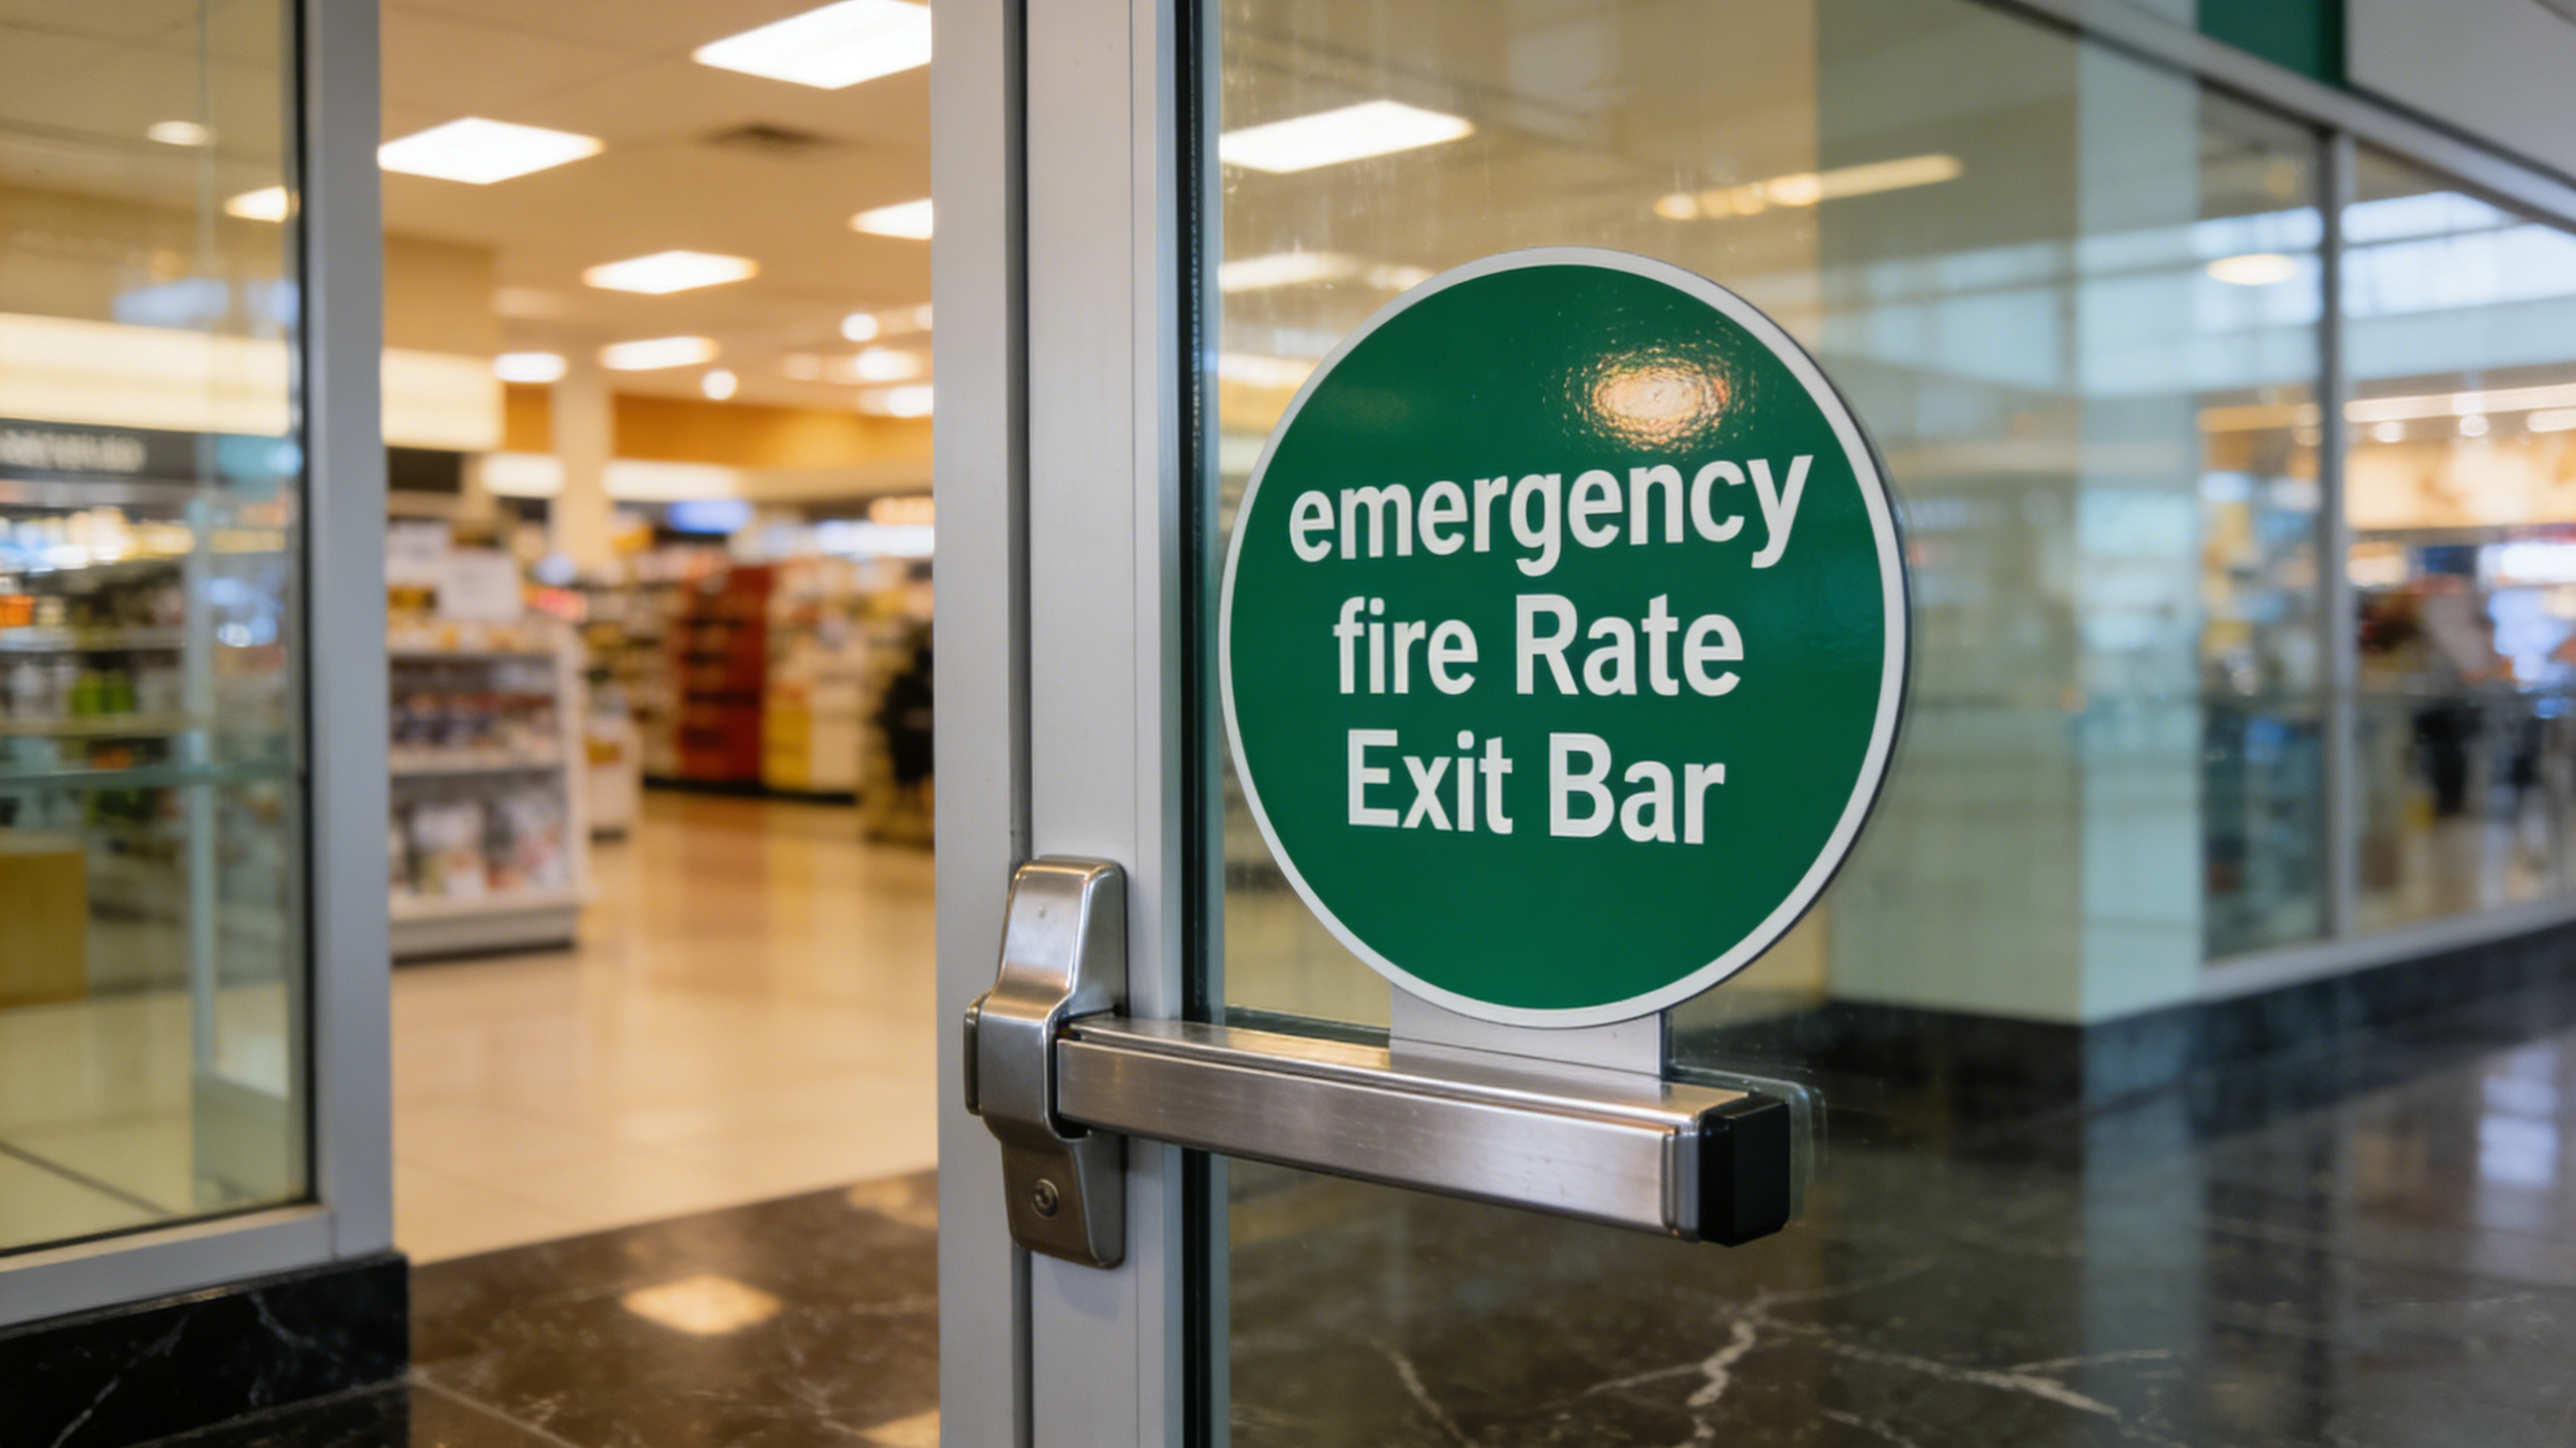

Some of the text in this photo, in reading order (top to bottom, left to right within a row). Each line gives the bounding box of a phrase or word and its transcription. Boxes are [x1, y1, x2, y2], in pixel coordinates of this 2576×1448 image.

[1289, 455, 1814, 577] emergency
[1333, 593, 1744, 696] fire Rate
[1347, 729, 1726, 844] Exit Bar
